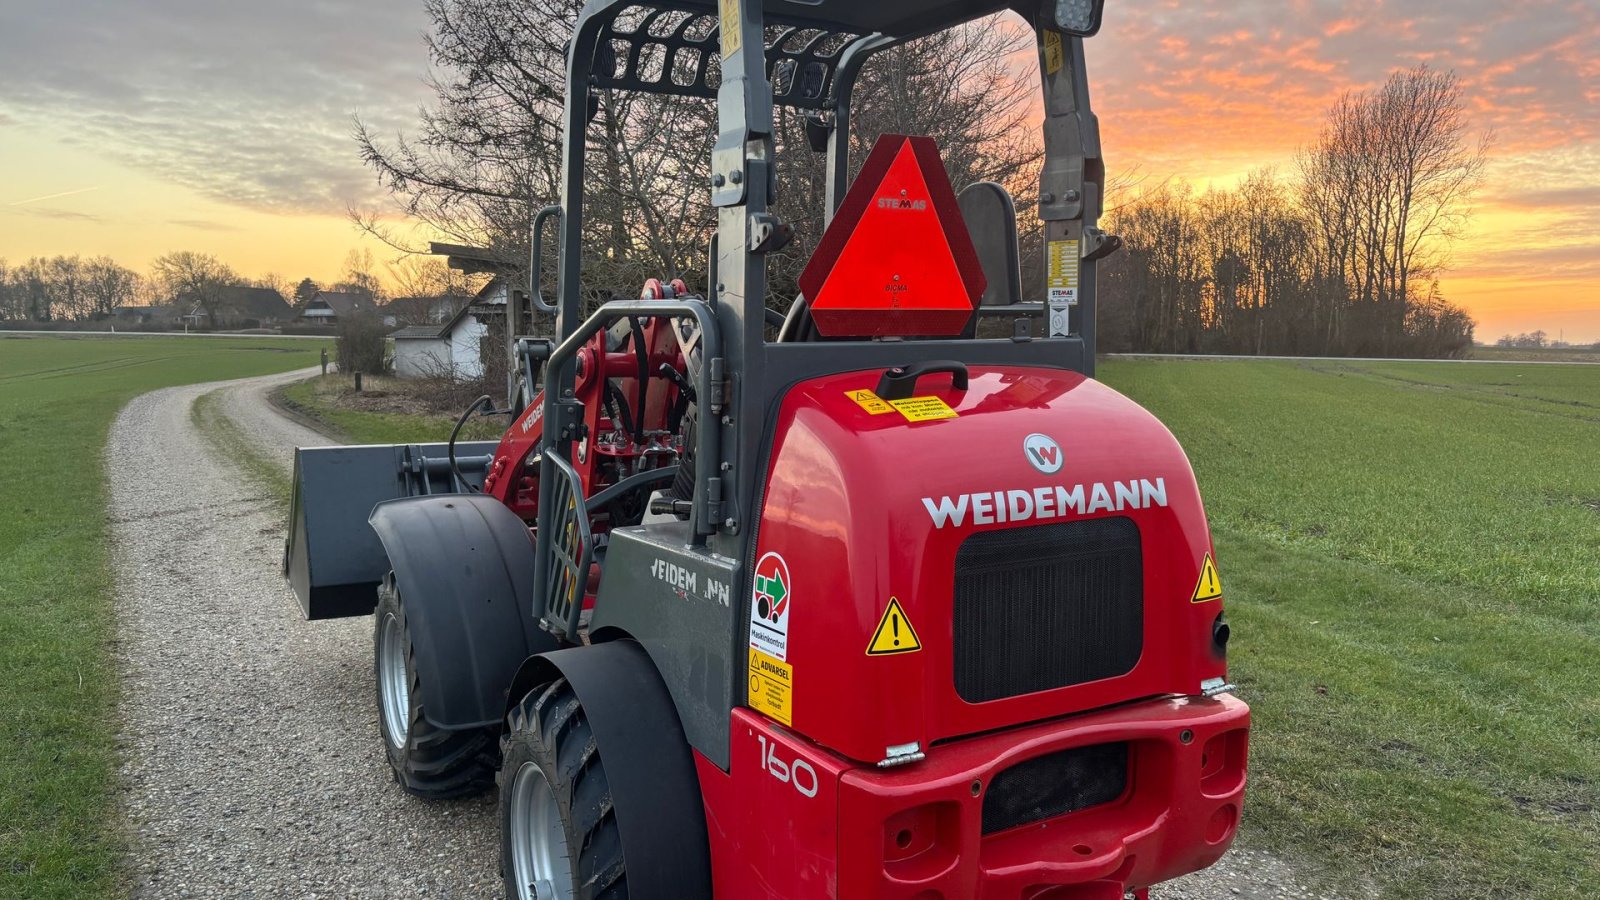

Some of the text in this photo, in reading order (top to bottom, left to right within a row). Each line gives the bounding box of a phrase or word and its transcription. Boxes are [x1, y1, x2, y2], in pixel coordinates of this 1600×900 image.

[878, 198, 927, 210] STEMAS
[921, 477, 1168, 529] WEIDEMANN
[751, 629, 785, 649] Maskinkontrol
[761, 660, 789, 680] ADVARSEL
